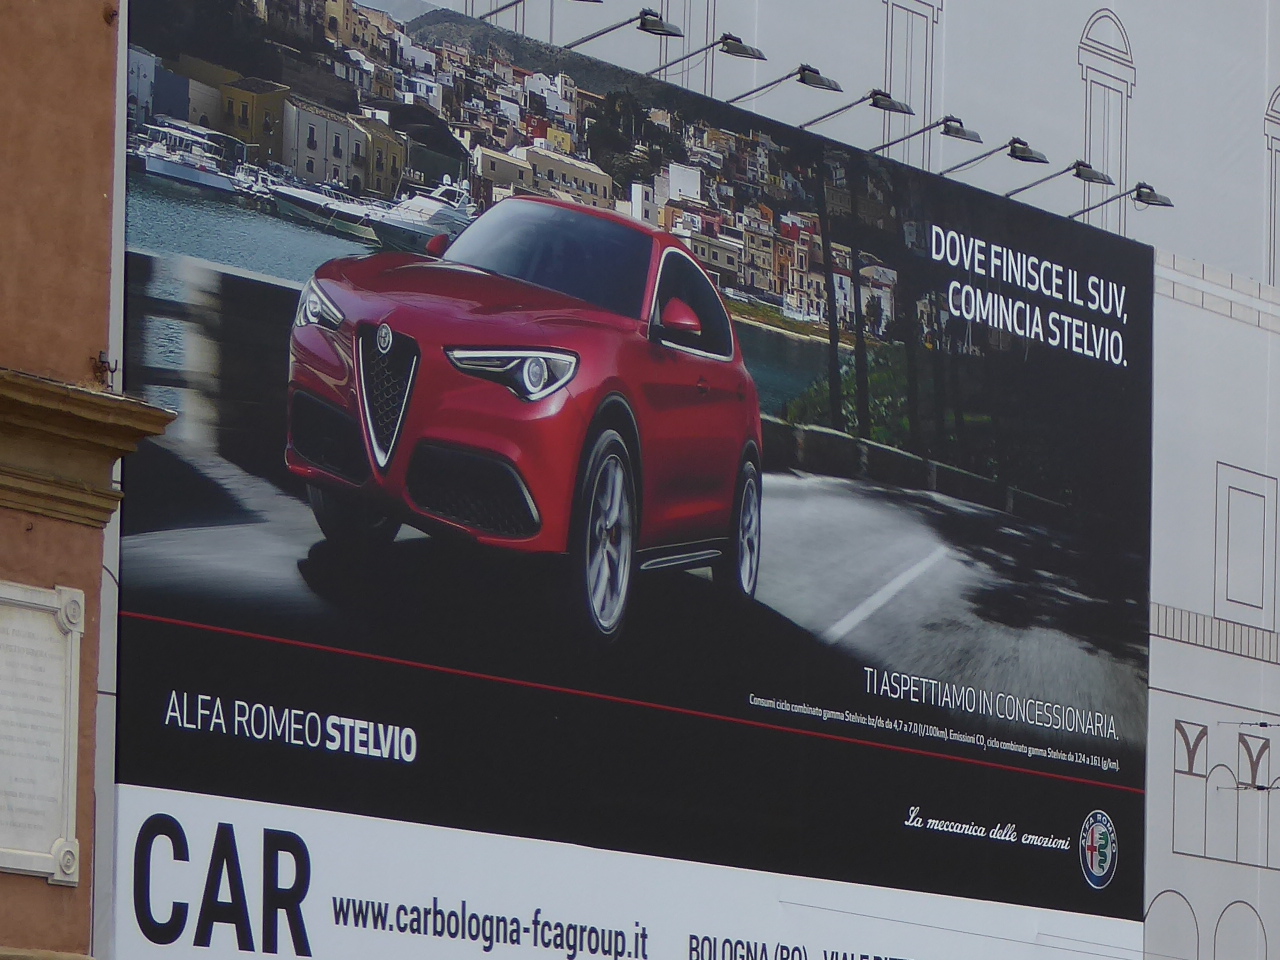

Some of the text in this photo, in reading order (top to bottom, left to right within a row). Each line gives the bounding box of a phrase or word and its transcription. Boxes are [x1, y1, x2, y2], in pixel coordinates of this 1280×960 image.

[932, 225, 1128, 324] DOVE FINISCE IL SUV,
[948, 280, 1128, 367] COMINCIA STELVIO.
[165, 690, 417, 762] ALFA ROMEO STELVIO
[749, 693, 776, 709] Consumi
[791, 703, 822, 717] combinato
[864, 667, 1119, 741] TI ASPETTIAMO IN CONCESSIONARIA.
[904, 806, 1071, 850] La meccanica delle emozioni
[133, 812, 312, 957] CAR
